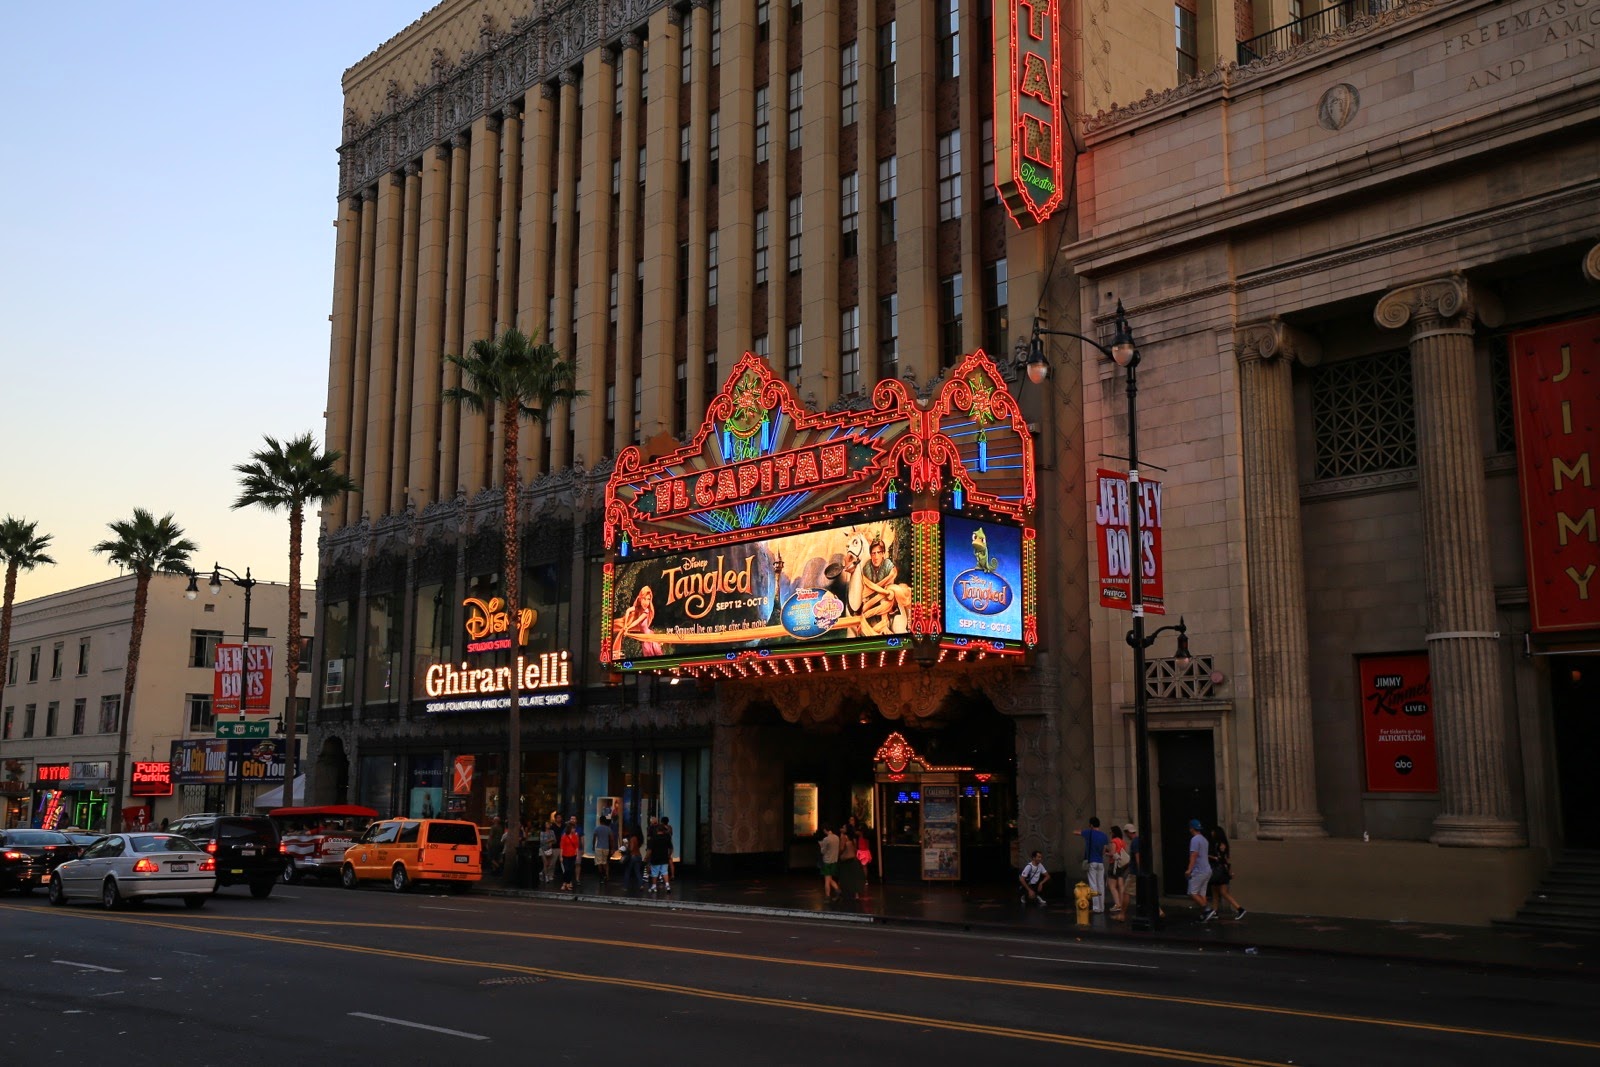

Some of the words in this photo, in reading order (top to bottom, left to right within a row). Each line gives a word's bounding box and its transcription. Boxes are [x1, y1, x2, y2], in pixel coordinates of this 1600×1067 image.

[1467, 59, 1526, 92] AND
[1021, 162, 1056, 194] Theatre
[655, 479, 689, 514] EL
[695, 444, 847, 506] CAPITAN
[1552, 345, 1599, 601] JIMMY
[1106, 528, 1156, 577] BOS
[661, 555, 756, 619] Tangled
[959, 580, 1008, 611] Tangled
[716, 601, 734, 611] SEPT
[735, 600, 742, 608] 12
[747, 598, 762, 607] OCT
[763, 597, 768, 605] 8
[463, 597, 534, 646] Disny
[959, 618, 978, 629] SEPT
[979, 620, 986, 630] 12
[991, 622, 1005, 632] OCT
[1006, 624, 1011, 633] 8
[215, 646, 273, 672] JERSEY
[221, 671, 264, 698] BOYS
[1375, 677, 1401, 687] JIMMY
[426, 703, 445, 712] SODA
[446, 700, 481, 711] FOUNTAIN
[498, 695, 545, 709] CHOLATE
[545, 694, 569, 706] SHOP
[1405, 704, 1426, 712] LIVE!
[250, 725, 265, 733] Fwy
[136, 763, 170, 773] Public
[191, 746, 205, 774] City
[205, 747, 226, 772] Tours
[242, 759, 265, 778] City
[265, 759, 297, 777] Tous
[1395, 760, 1412, 768] abc
